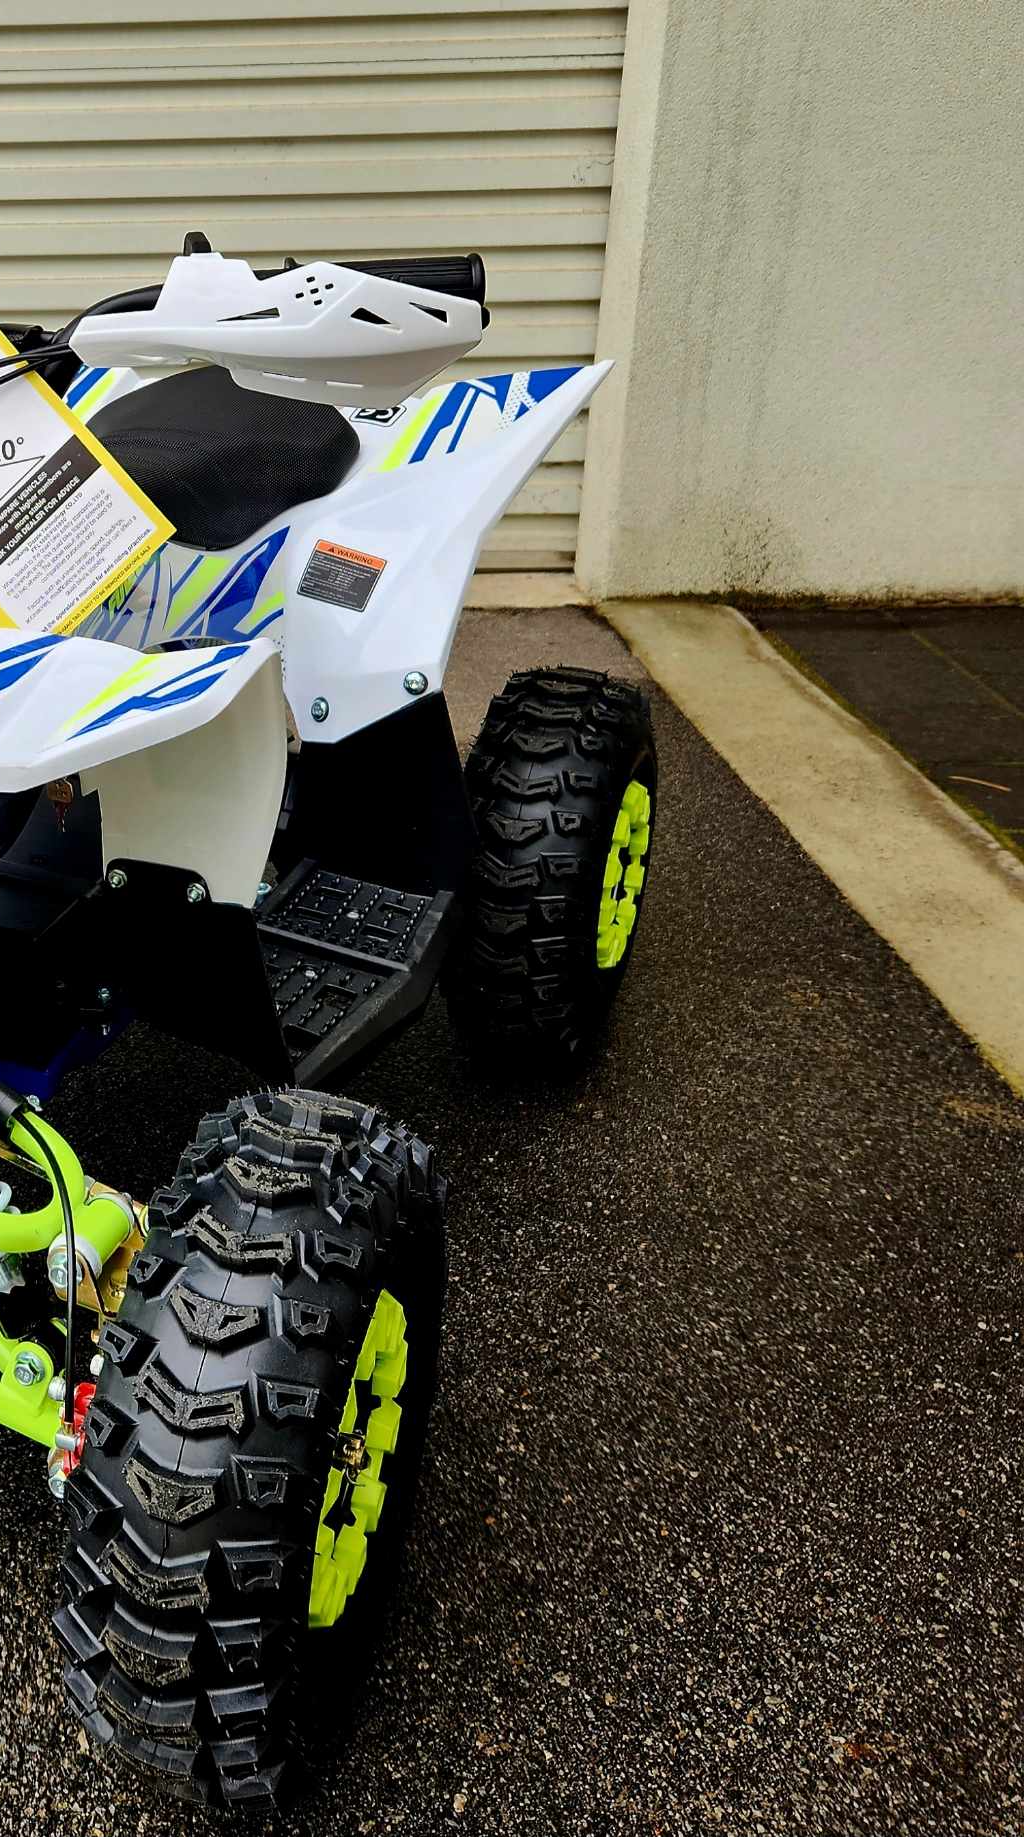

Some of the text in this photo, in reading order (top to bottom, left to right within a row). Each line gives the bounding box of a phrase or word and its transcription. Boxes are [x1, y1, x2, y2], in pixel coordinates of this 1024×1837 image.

[5, 508, 22, 525] with
[18, 491, 41, 514] higher
[35, 468, 63, 496] numbers
[60, 459, 73, 472] are
[16, 469, 49, 502] VEHICLES
[3, 530, 24, 551] YOUR
[19, 508, 47, 535] DEALER
[42, 496, 59, 513] FOR
[54, 474, 81, 501] ADVICE
[13, 495, 48, 531] more stable
[336, 549, 373, 565] WARNING
